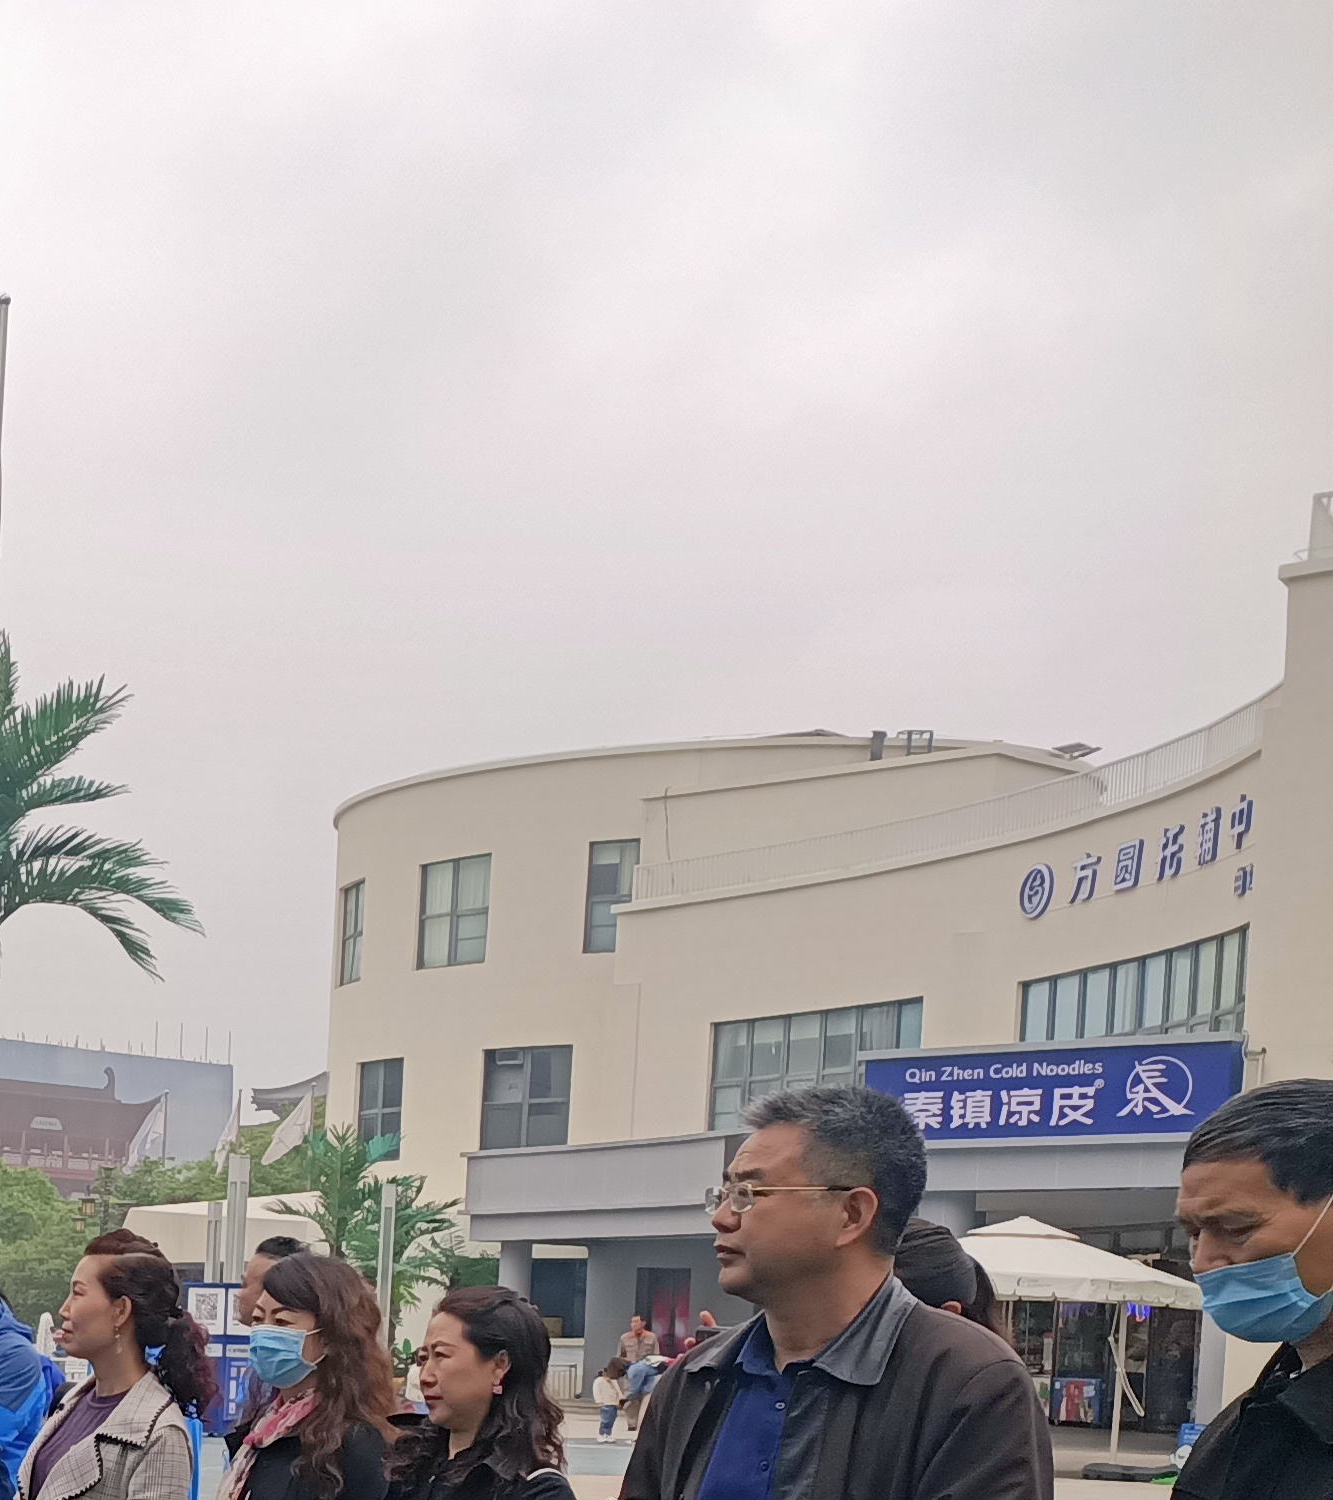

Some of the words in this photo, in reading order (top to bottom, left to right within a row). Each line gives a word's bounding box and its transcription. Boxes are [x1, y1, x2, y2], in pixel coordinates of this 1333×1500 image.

[905, 1068, 936, 1084] Qin
[940, 1066, 984, 1082] Zhen
[989, 1062, 1028, 1079] Cold
[1033, 1059, 1103, 1077] Noodles
[900, 1085, 1097, 1130] 秦镇凉皮
